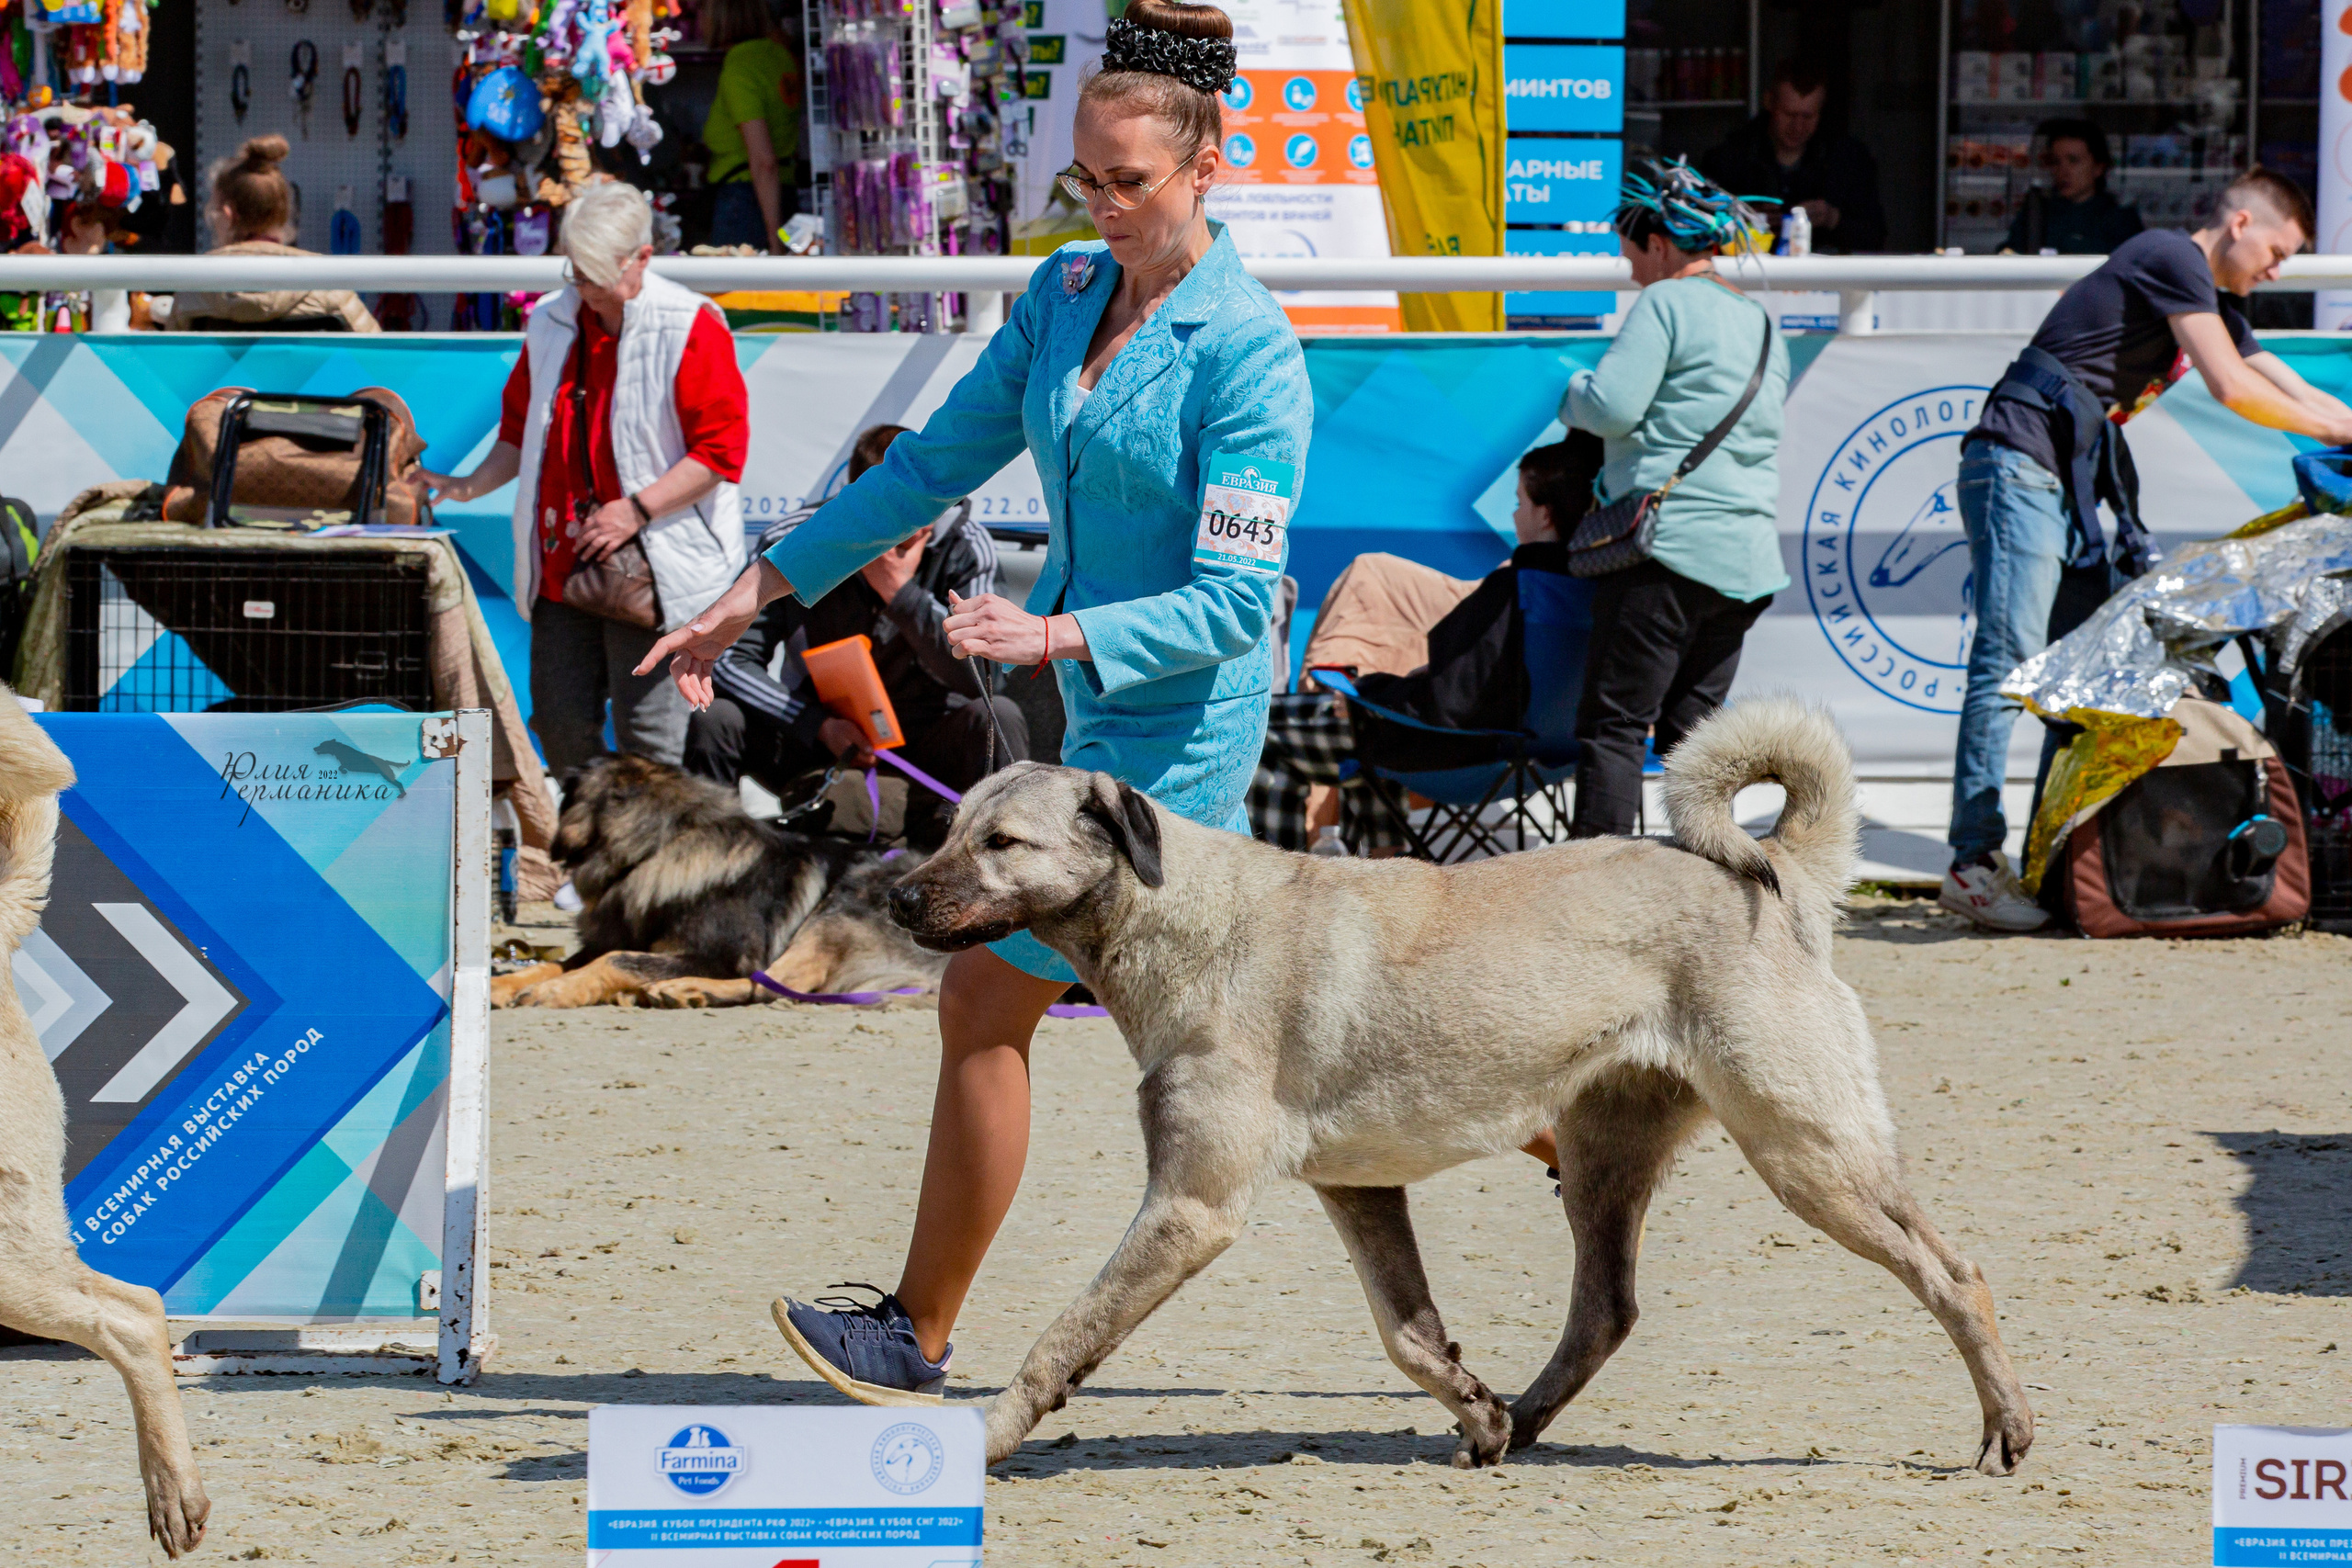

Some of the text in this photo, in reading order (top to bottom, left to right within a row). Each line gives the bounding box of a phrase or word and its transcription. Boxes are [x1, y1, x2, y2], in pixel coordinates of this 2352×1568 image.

[1221, 475, 1279, 494] ЕВРАЗИЯ
[1208, 509, 1275, 545] 0643
[1217, 553, 1256, 566] 21.05.2022
[85, 1134, 184, 1232] ВСЕМИРНАЯ
[182, 1052, 270, 1135] ВЫСТАВКА
[101, 1027, 324, 1245] СОБАК РОССИЙСКИХ ПОРОД
[662, 1450, 738, 1469] Farmina
[2239, 1457, 2247, 1500] PREMIUM
[2255, 1458, 2352, 1500] SIR
[662, 1519, 695, 1529] КУБОК
[698, 1518, 763, 1529] ПРЕЗИДЕНТА
[879, 1517, 912, 1527] КУБОК
[916, 1517, 934, 1527] СНГ
[661, 1531, 721, 1541] ВСЕМИРНАЯ
[724, 1531, 777, 1540] ВЫСТАВКА
[780, 1530, 812, 1540] СОБАК
[816, 1529, 882, 1540] РОССИЙСКИХ
[885, 1529, 921, 1540] ПОРОД
[2291, 1539, 2326, 1548] КУБОК
